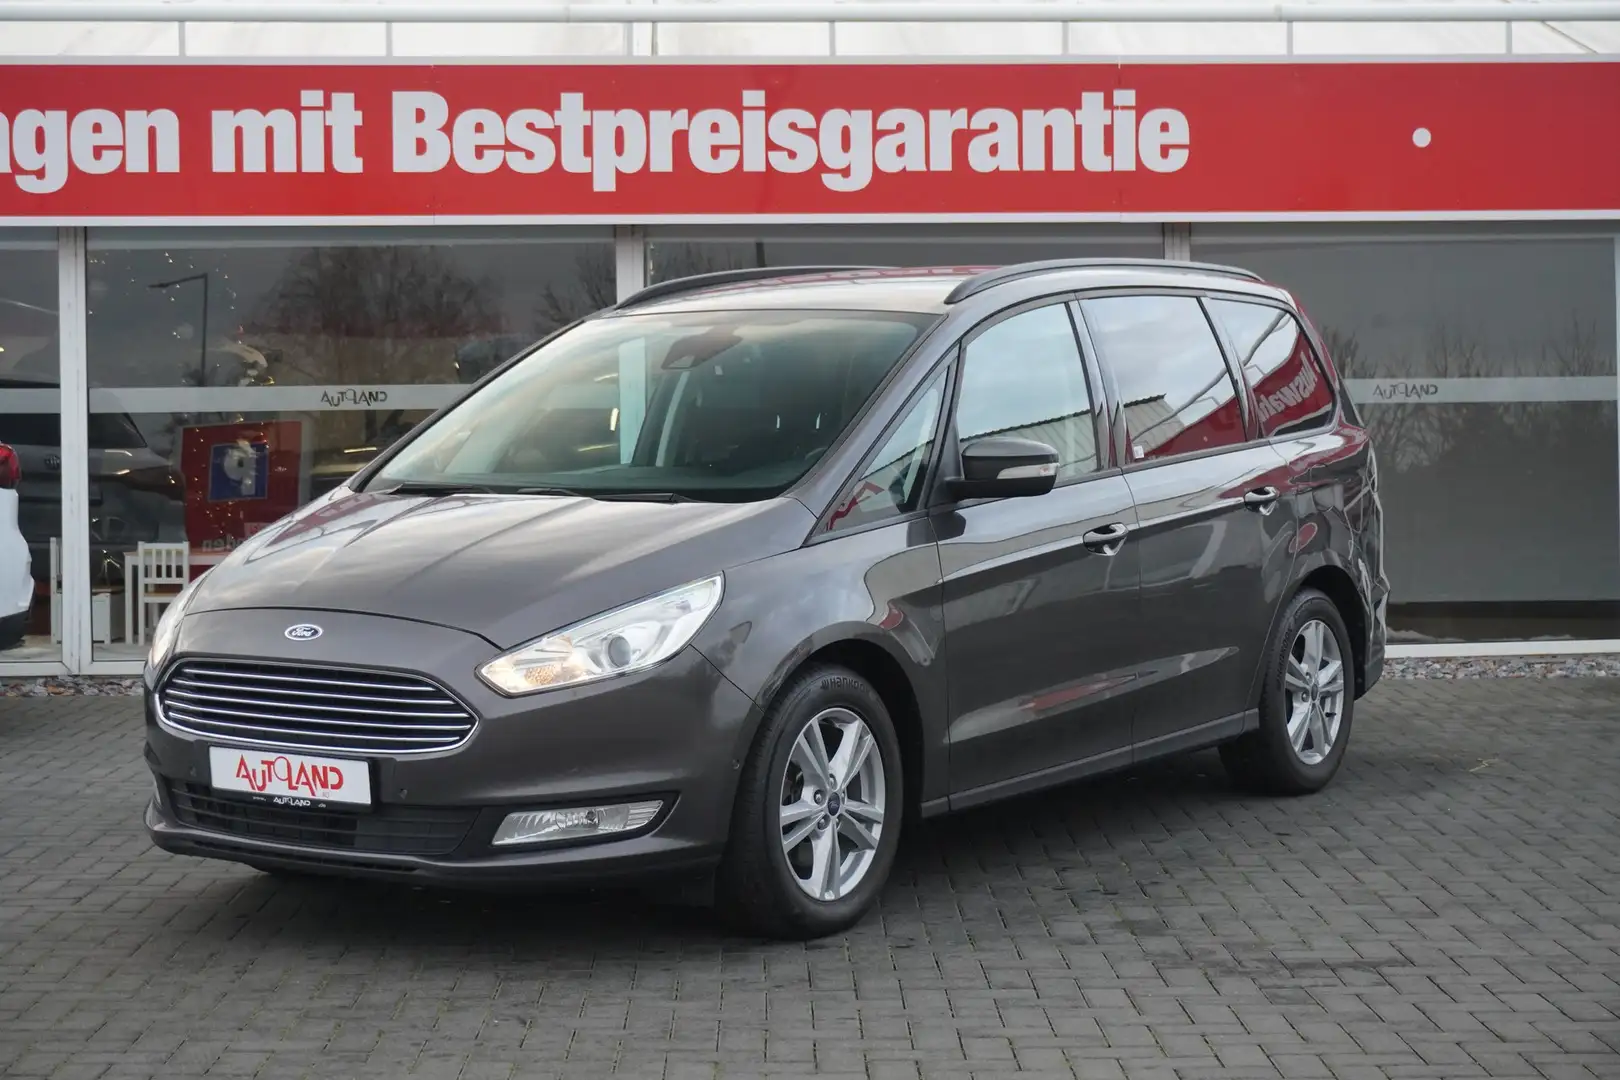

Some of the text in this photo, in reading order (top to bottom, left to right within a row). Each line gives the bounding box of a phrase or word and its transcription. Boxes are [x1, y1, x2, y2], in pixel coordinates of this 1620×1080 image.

[0, 89, 1190, 194] gen mit Bestpreisgarantie
[235, 753, 345, 797] AUTOLAND
[273, 796, 311, 807] AUTOLAND
